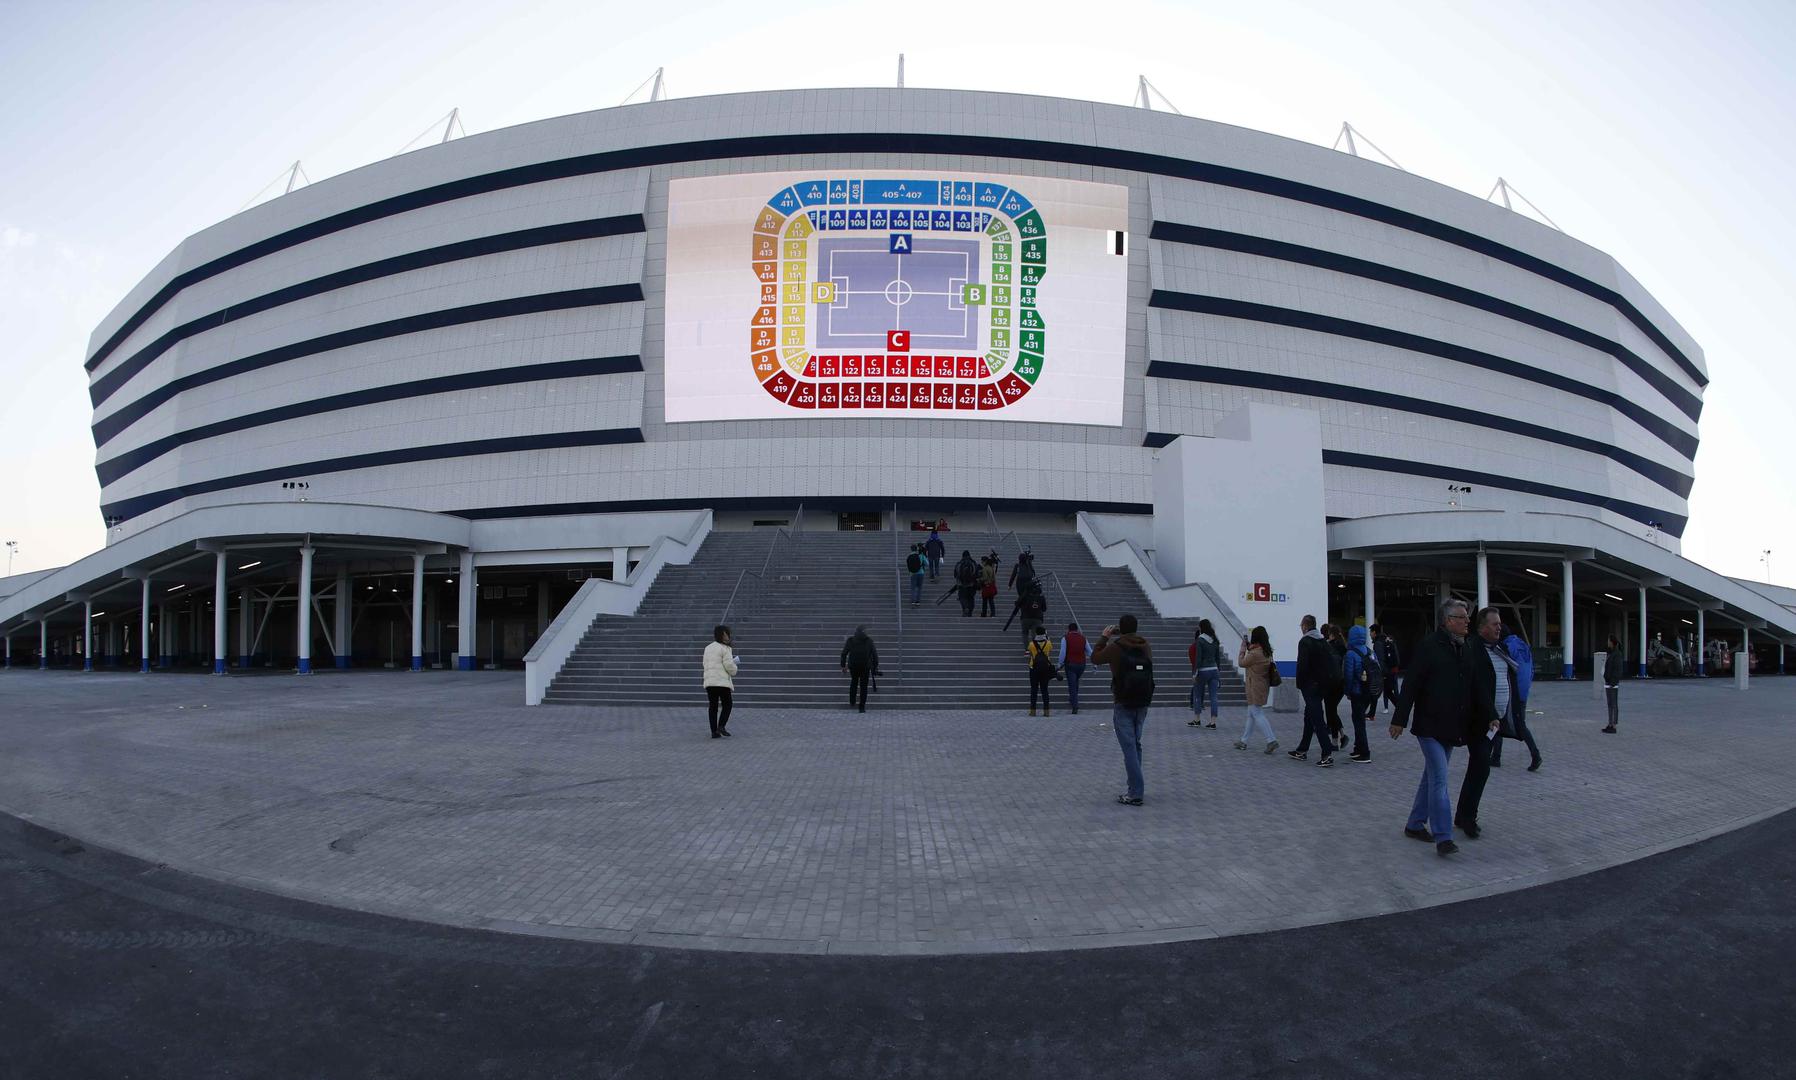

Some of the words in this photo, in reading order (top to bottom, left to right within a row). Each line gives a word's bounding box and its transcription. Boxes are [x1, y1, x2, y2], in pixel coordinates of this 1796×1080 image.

[894, 236, 908, 249] A
[818, 286, 829, 299] D
[970, 288, 980, 301] B
[892, 333, 903, 346] C
[991, 360, 1001, 370] 129
[1259, 587, 1265, 597] C
